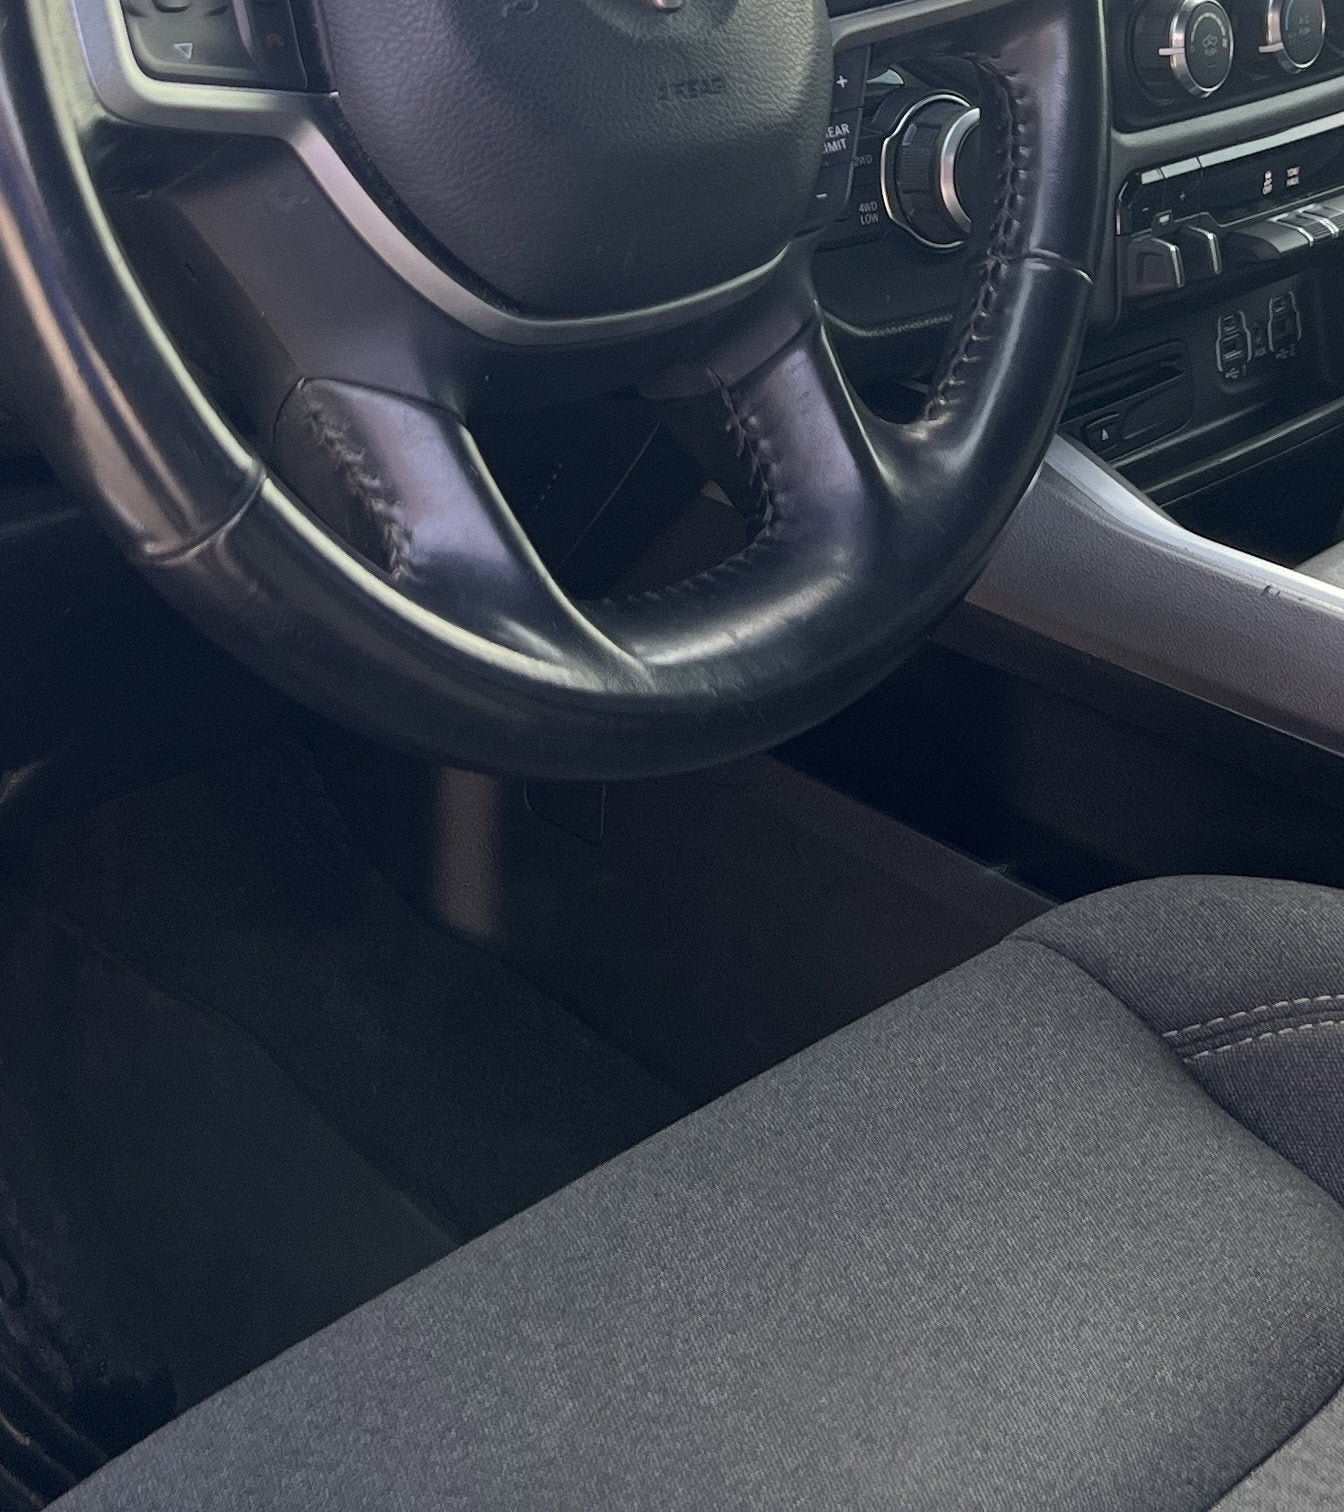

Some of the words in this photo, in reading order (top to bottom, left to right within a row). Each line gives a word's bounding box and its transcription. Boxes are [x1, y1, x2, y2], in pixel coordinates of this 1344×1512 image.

[825, 123, 850, 139] EAR
[823, 138, 847, 153] IMIT
[854, 154, 873, 167] 2WD
[858, 201, 878, 213] 4WD
[860, 213, 879, 225] LOW
